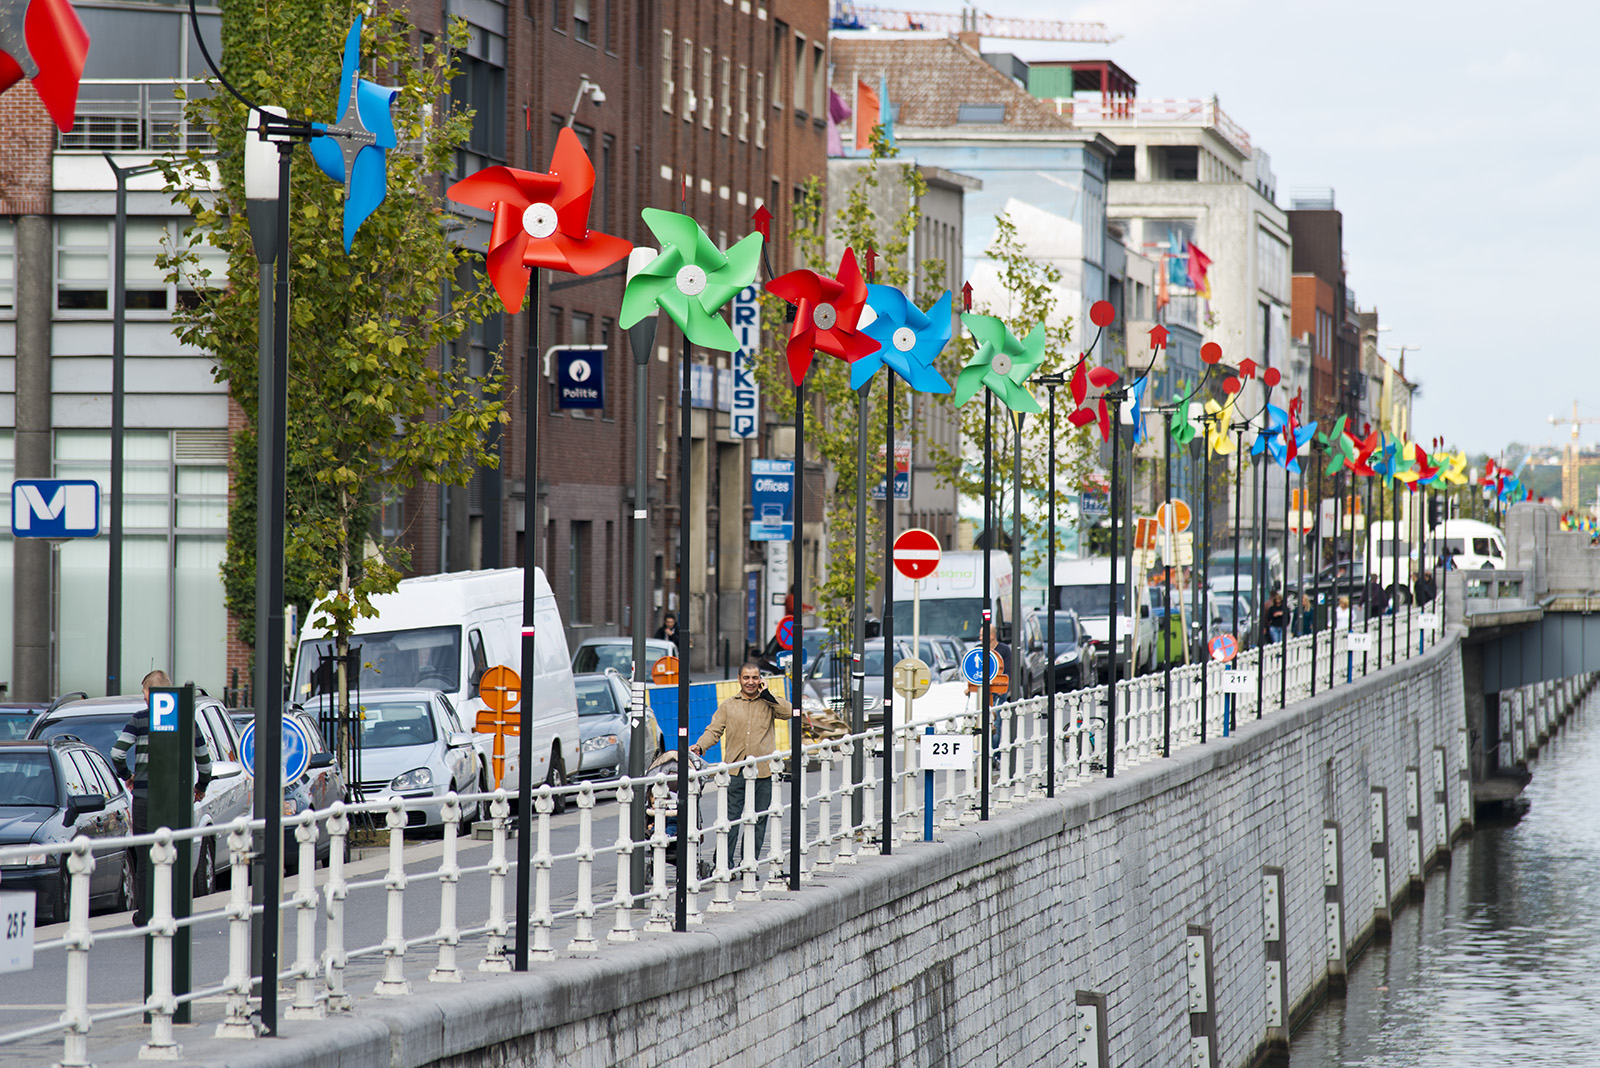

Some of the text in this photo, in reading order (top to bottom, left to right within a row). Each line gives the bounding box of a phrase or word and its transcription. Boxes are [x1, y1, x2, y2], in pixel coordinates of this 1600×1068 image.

[734, 285, 757, 409] DRINKS
[562, 387, 599, 399] Politie
[771, 462, 792, 472] RENT
[755, 478, 790, 492] Offices
[15, 485, 96, 530] M
[1230, 675, 1248, 683] 21 F
[153, 692, 175, 726] P
[933, 743, 960, 755] 23 F
[7, 911, 27, 939] 25 F
